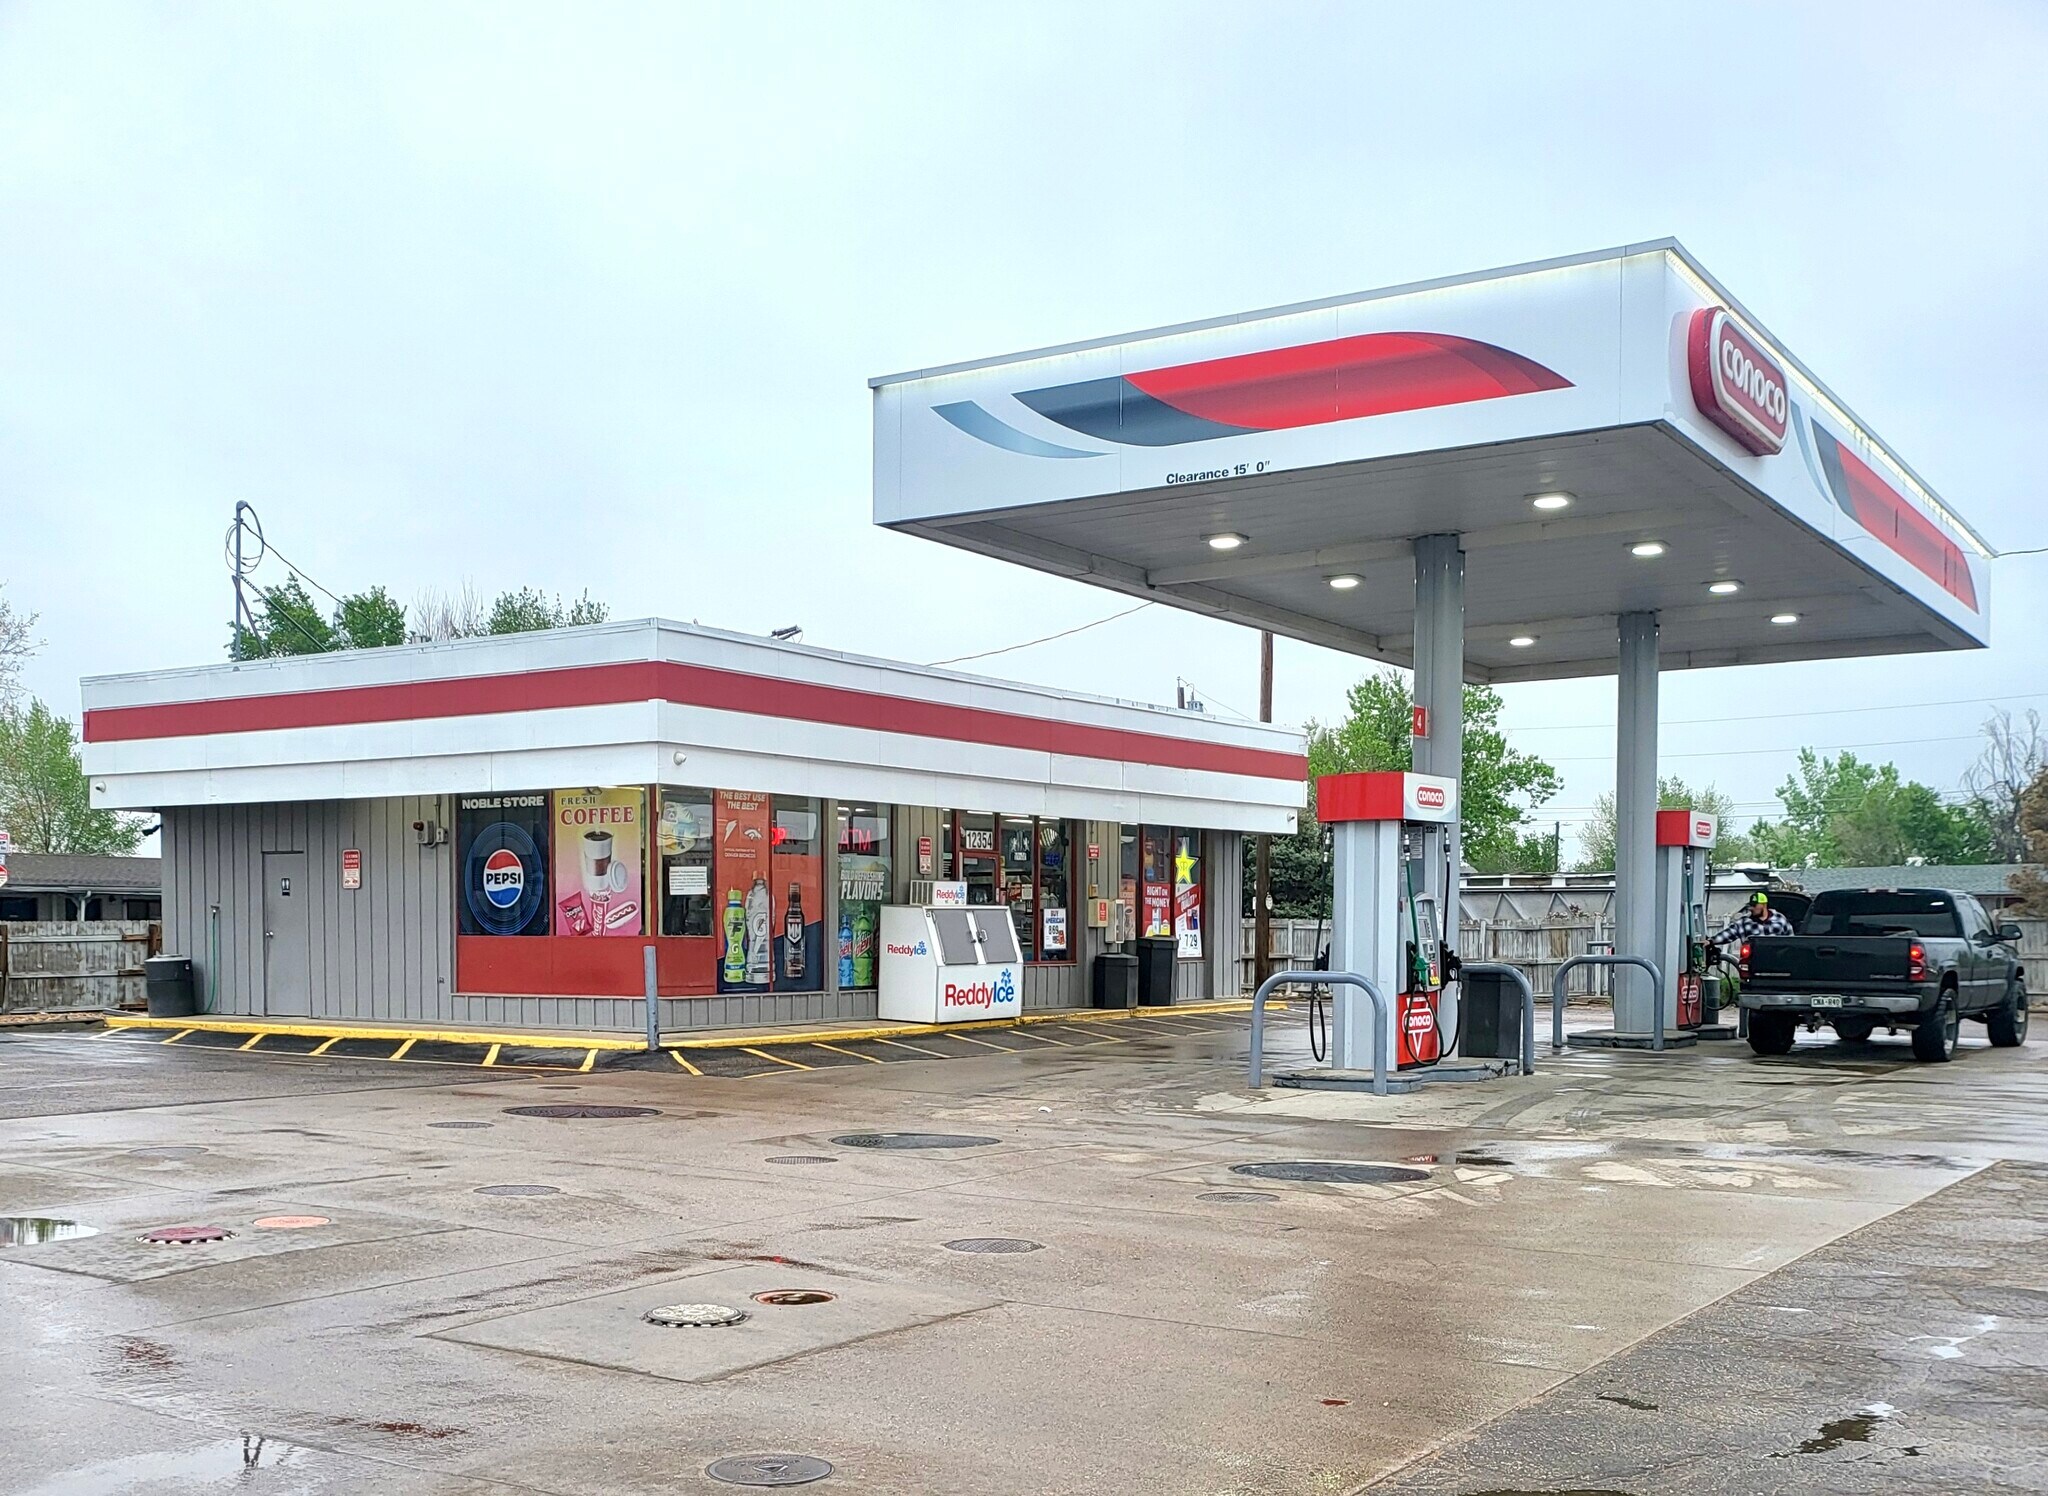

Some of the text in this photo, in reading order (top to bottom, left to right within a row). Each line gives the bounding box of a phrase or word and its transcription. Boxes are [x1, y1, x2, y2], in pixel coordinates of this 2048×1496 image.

[1166, 460, 1271, 484] Clearance 15' 0"
[1417, 714, 1422, 730] 4
[462, 795, 545, 810] NOBLE STORE
[561, 796, 596, 806] FRESH
[720, 791, 766, 802] THE BEST USE
[727, 801, 759, 811] THE BEST
[560, 806, 635, 826] COFFEE
[838, 829, 871, 851] ATM
[967, 830, 993, 849] 12354
[486, 872, 521, 885] PEPSI
[841, 880, 884, 900] FLAVORS
[1146, 886, 1162, 896] RIGHT
[1152, 897, 1169, 908] MONEY
